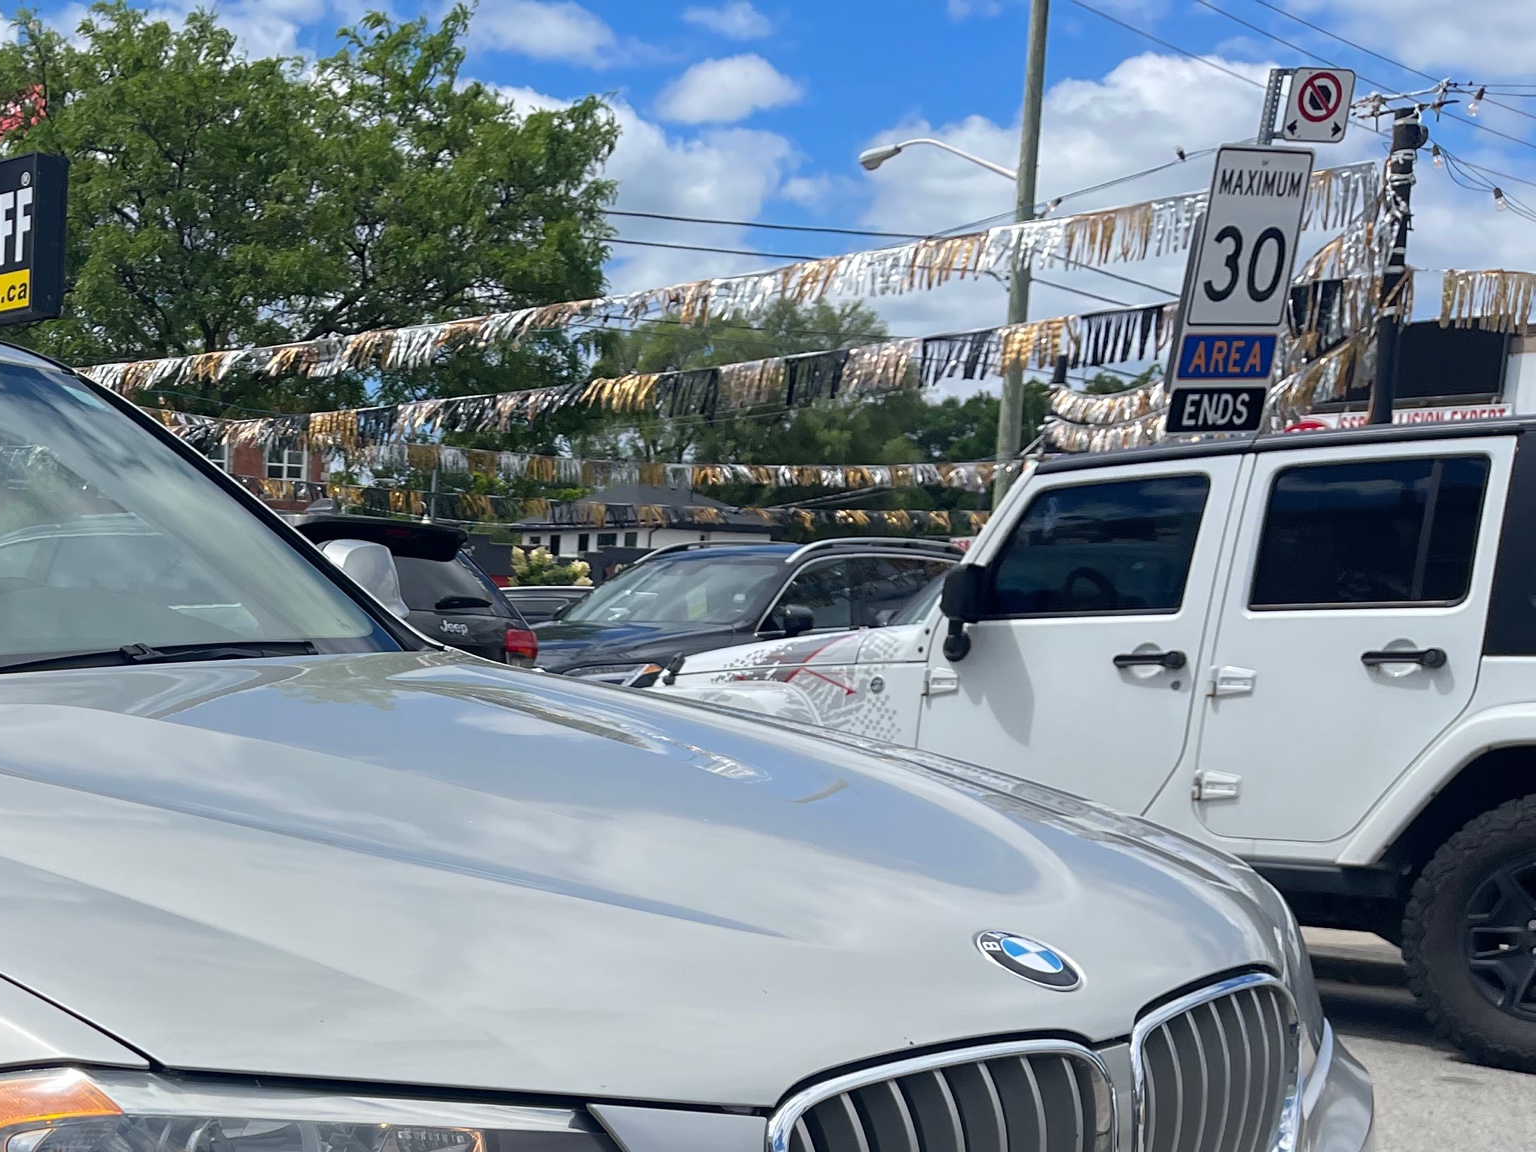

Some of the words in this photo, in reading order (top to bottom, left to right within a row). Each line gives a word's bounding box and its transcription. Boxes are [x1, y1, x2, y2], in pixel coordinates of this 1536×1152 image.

[1218, 168, 1304, 198] MAXIMUM
[1203, 225, 1287, 303] 30
[1188, 340, 1262, 373] AREA
[1182, 393, 1250, 426] ENDS
[440, 619, 468, 636] Jeep
